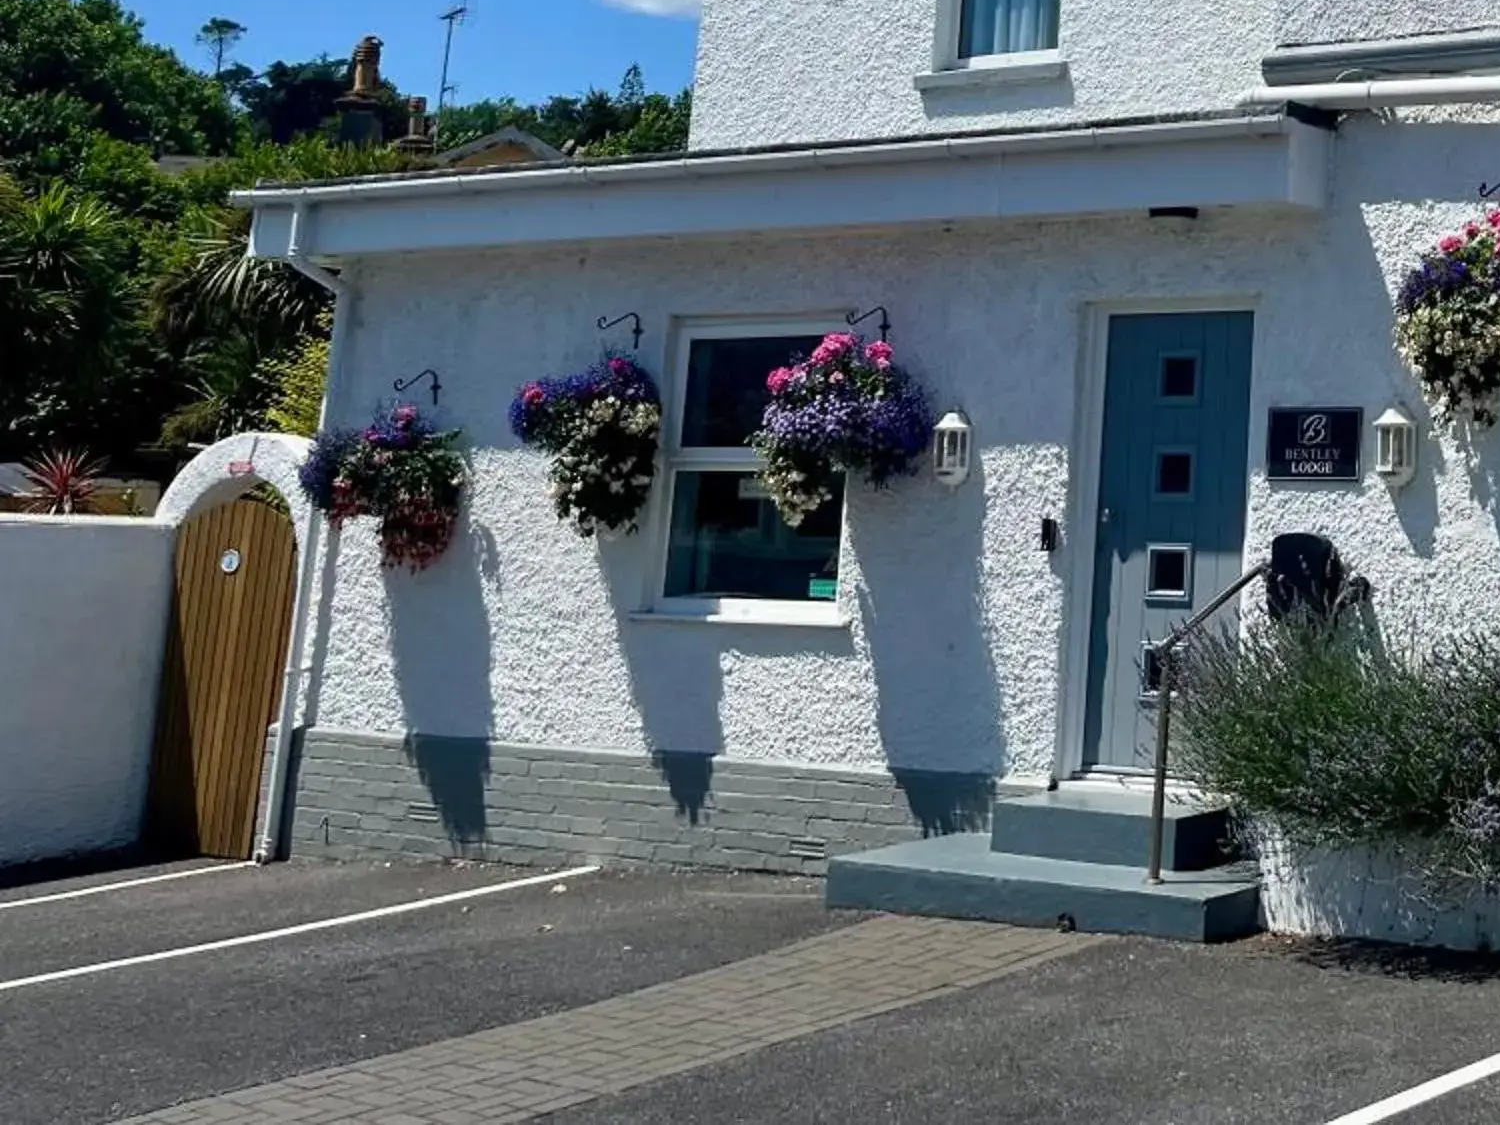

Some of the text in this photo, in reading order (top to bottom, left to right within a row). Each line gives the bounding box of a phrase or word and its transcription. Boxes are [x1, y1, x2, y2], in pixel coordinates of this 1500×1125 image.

[1303, 414, 1327, 445] B
[1285, 448, 1341, 460] BENTLEY
[1291, 461, 1333, 474] LODGE
